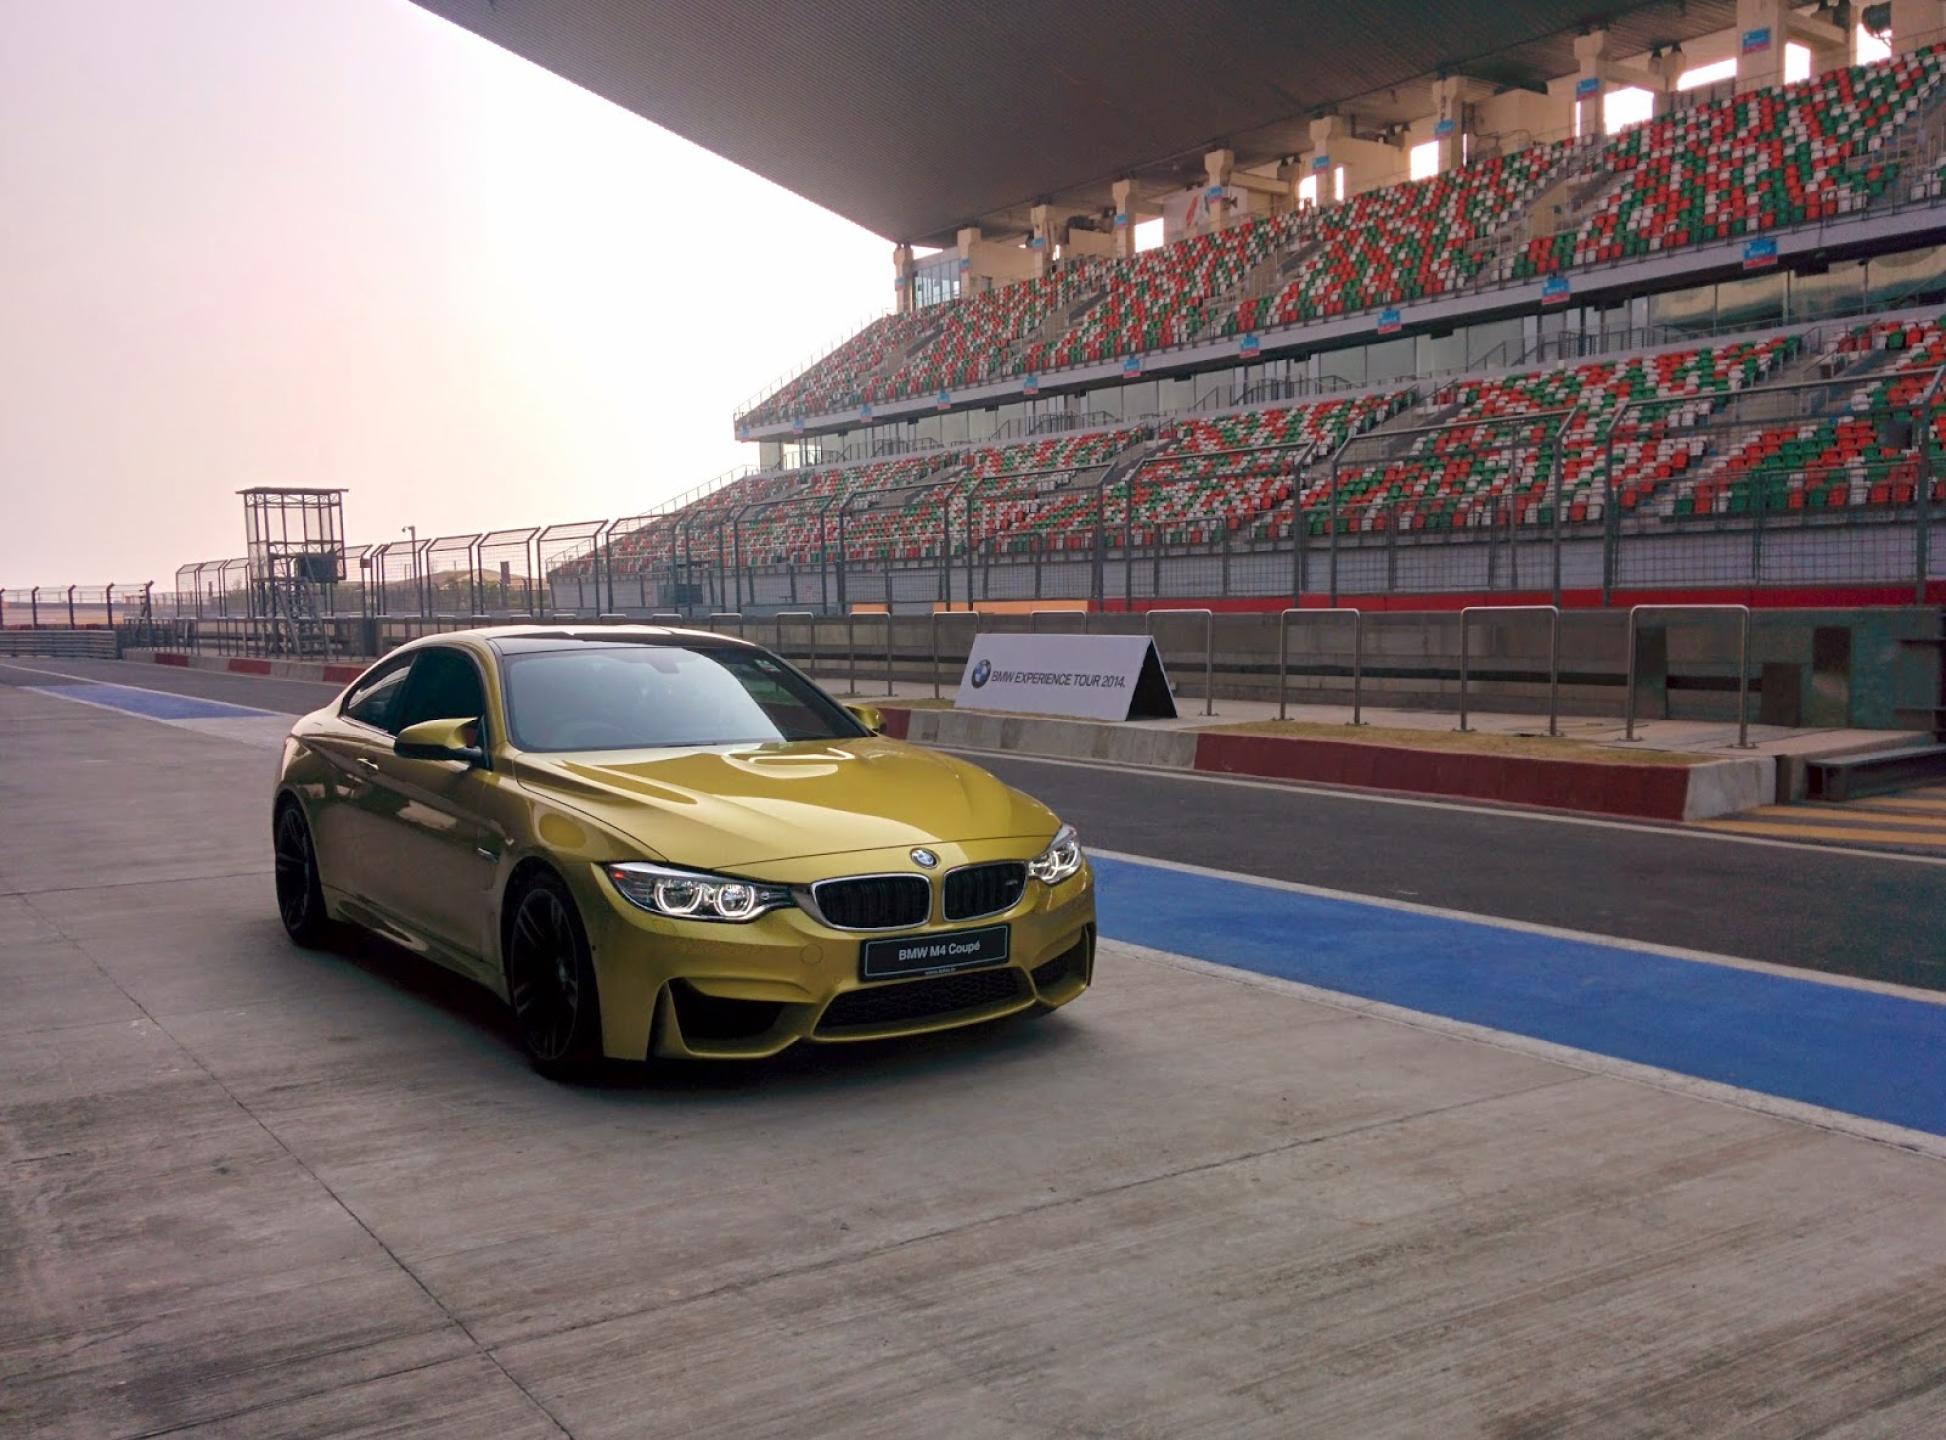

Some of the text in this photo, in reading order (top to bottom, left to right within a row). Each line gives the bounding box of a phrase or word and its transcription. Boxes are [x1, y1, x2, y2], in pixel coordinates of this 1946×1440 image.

[992, 671, 1014, 682] BMW
[1015, 672, 1072, 685] EXPERIENCE
[1074, 674, 1100, 687] TOUR
[898, 941, 980, 960] BMW M4 Coupé
